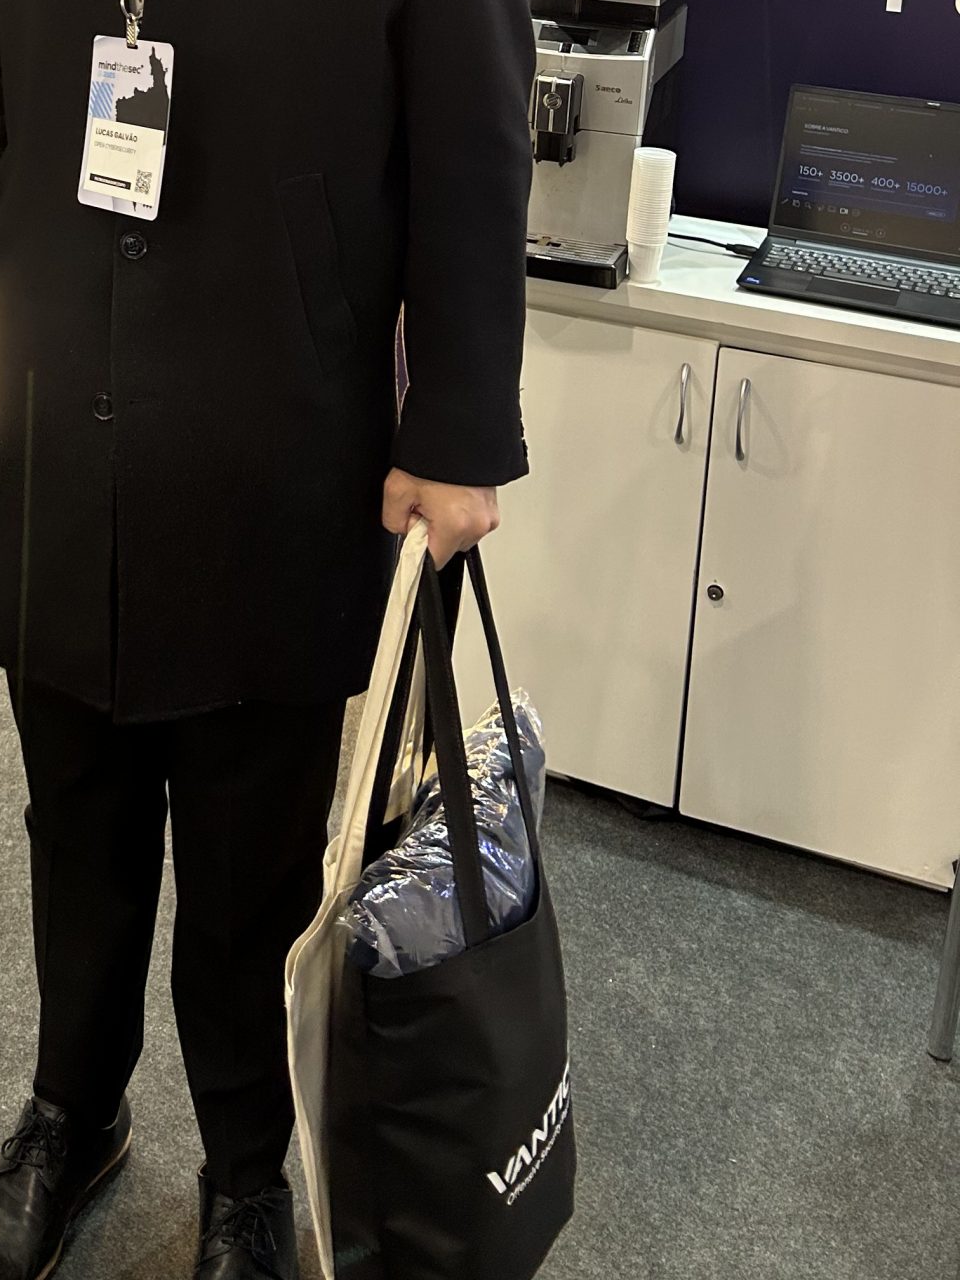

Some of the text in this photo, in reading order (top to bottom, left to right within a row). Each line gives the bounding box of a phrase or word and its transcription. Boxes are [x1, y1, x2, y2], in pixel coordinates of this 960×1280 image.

[595, 85, 622, 94] Saeco
[95, 127, 114, 138] LUCAS
[799, 165, 823, 177] 150+
[829, 170, 865, 184] 3500+
[871, 176, 900, 189] 400+
[906, 181, 948, 196] 15000+
